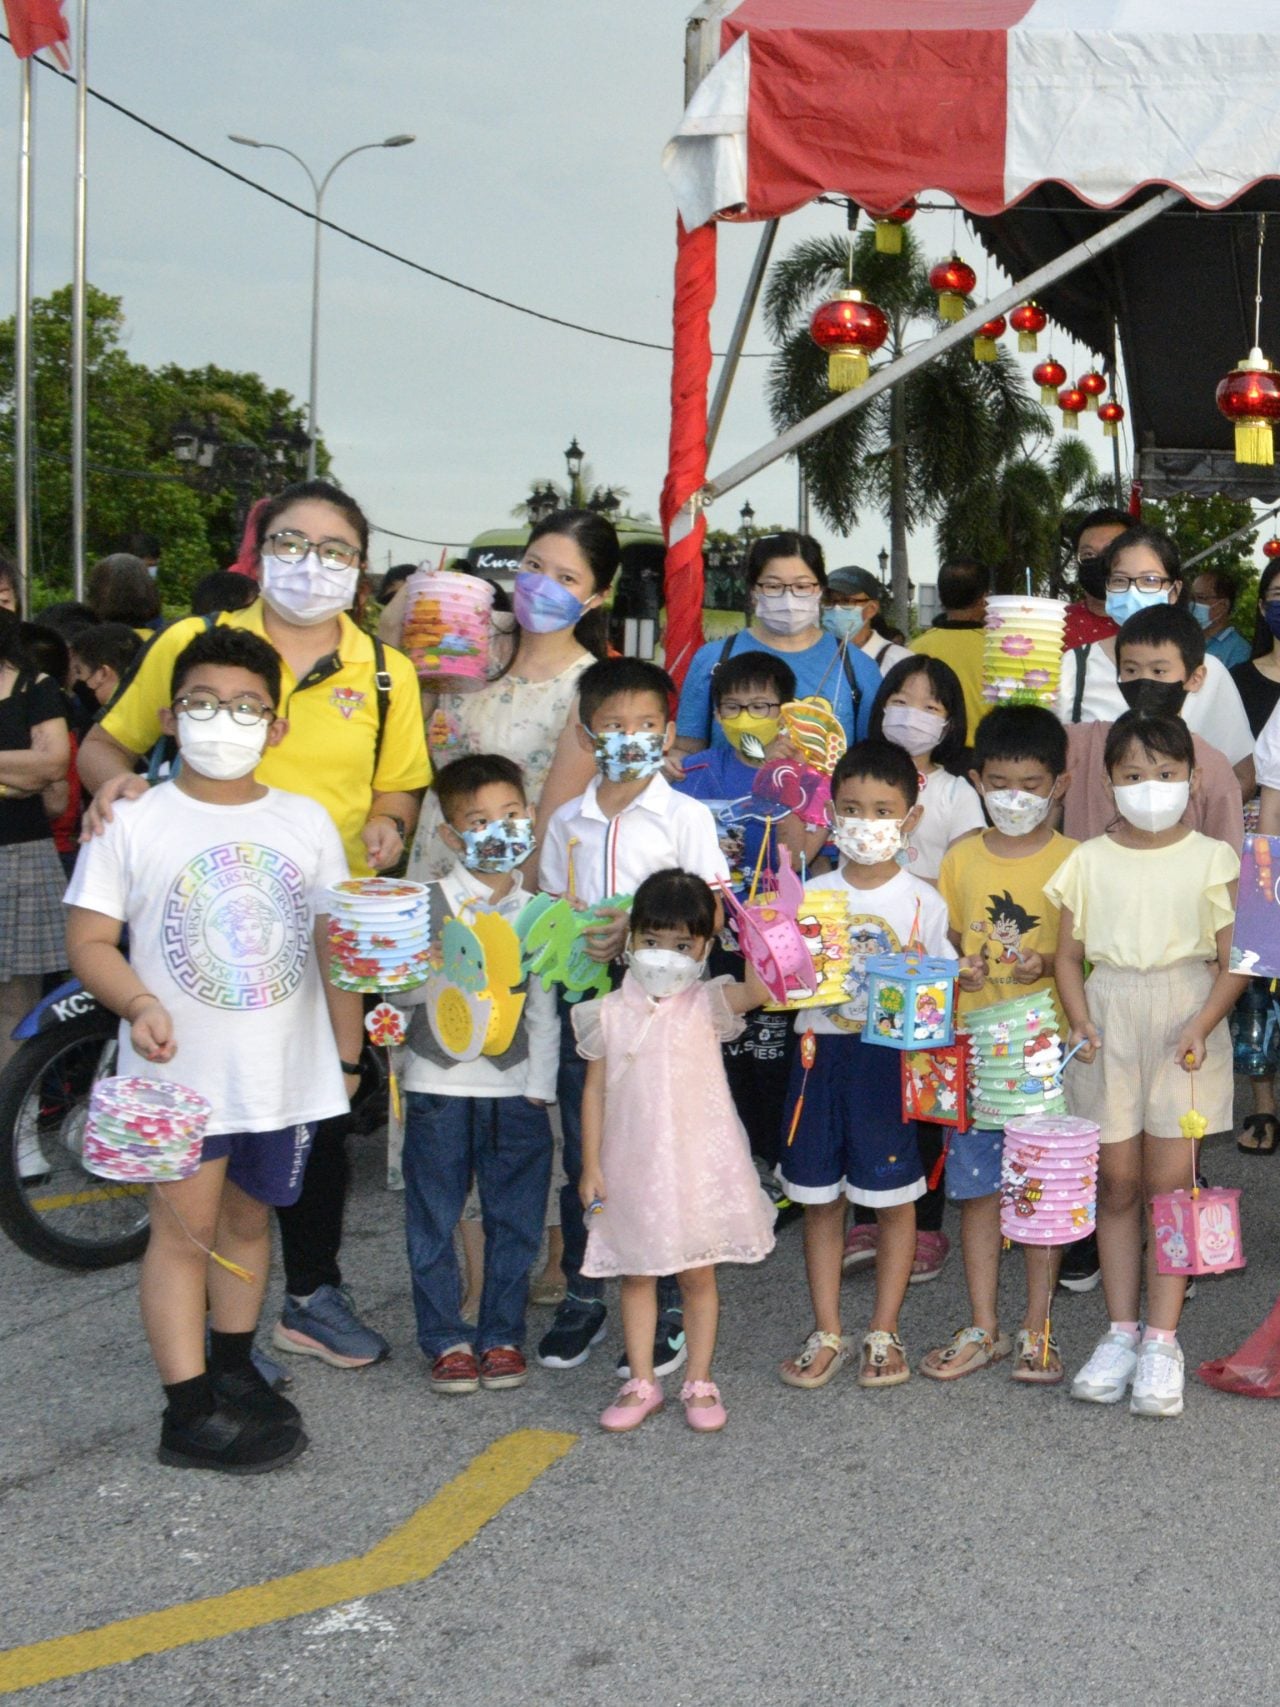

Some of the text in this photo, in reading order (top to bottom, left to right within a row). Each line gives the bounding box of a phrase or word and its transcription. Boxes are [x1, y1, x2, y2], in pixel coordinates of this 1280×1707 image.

[476, 553, 521, 568] Kwe
[210, 869, 264, 890] VERSACE
[187, 887, 212, 947] VERSACE
